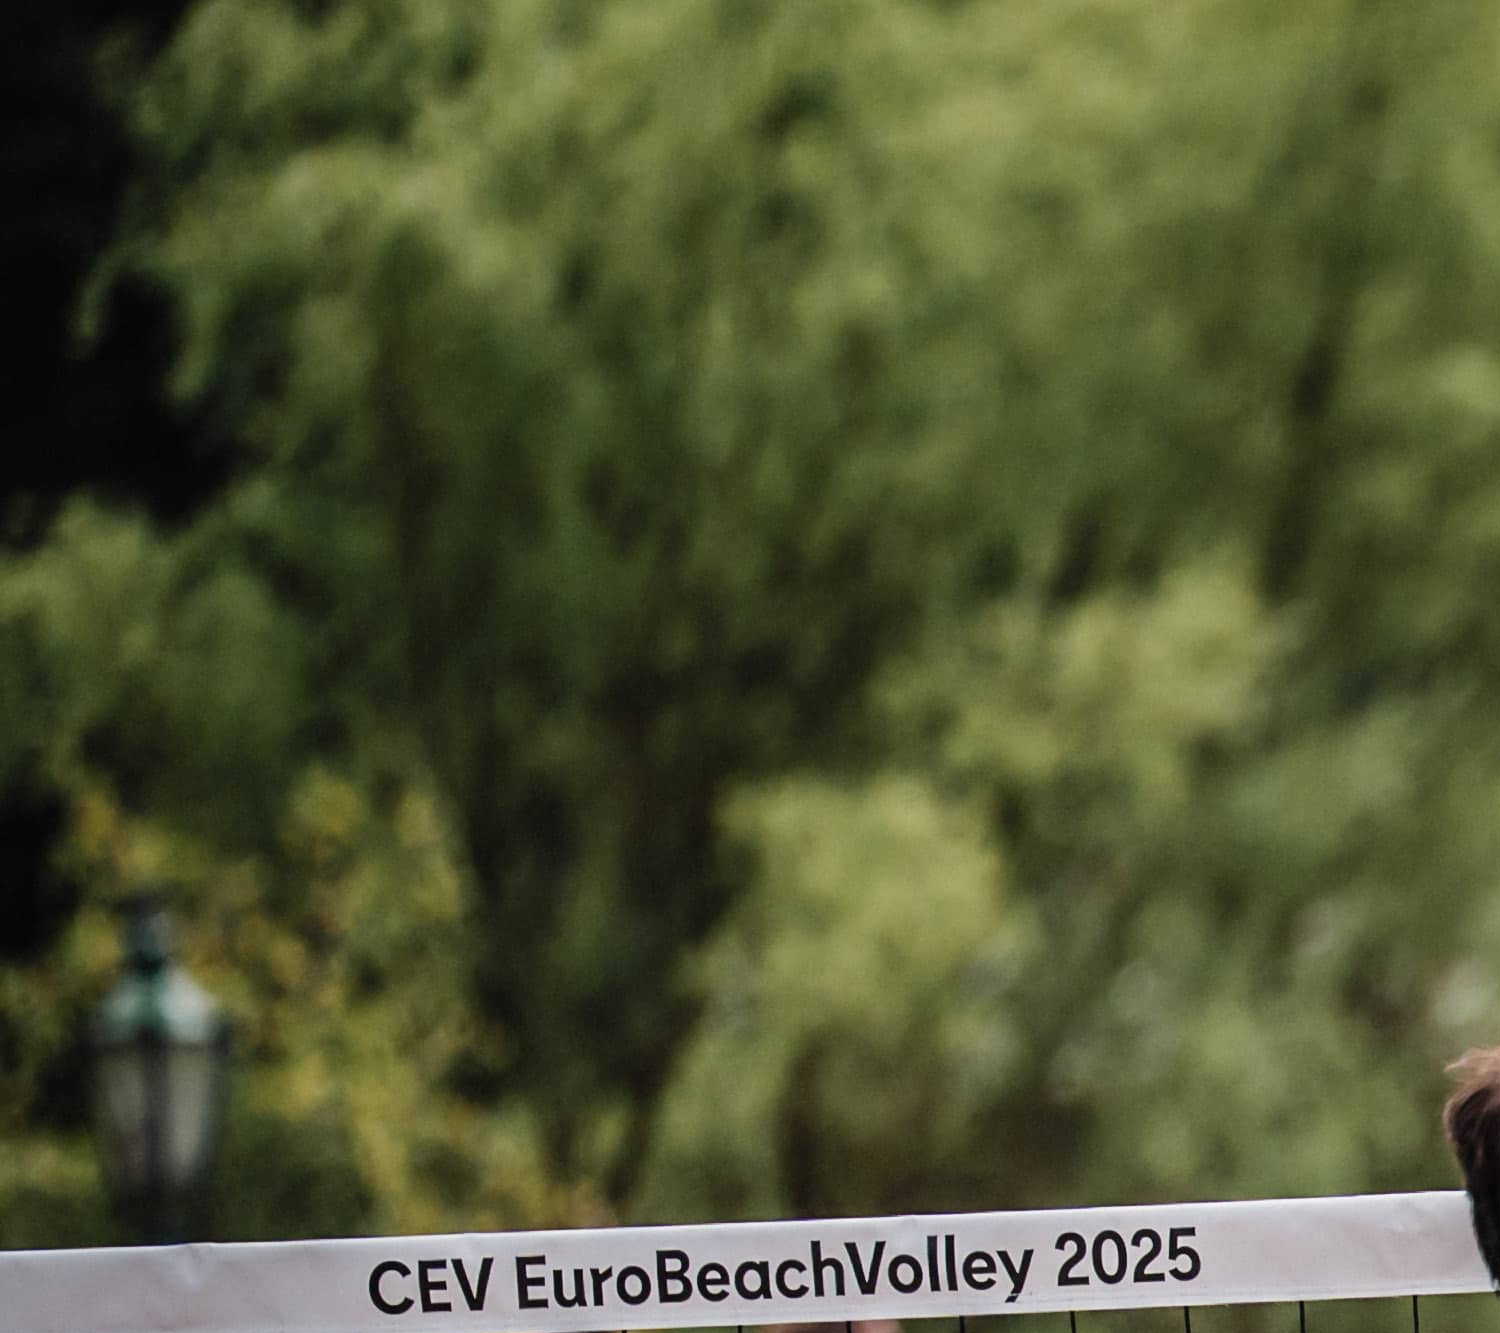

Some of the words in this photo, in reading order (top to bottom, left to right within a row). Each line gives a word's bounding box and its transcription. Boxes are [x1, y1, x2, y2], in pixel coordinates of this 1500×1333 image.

[367, 1256, 494, 1315] CEV
[515, 1234, 1036, 1310] EuroBeachVolley
[1055, 1226, 1202, 1288] 2025
